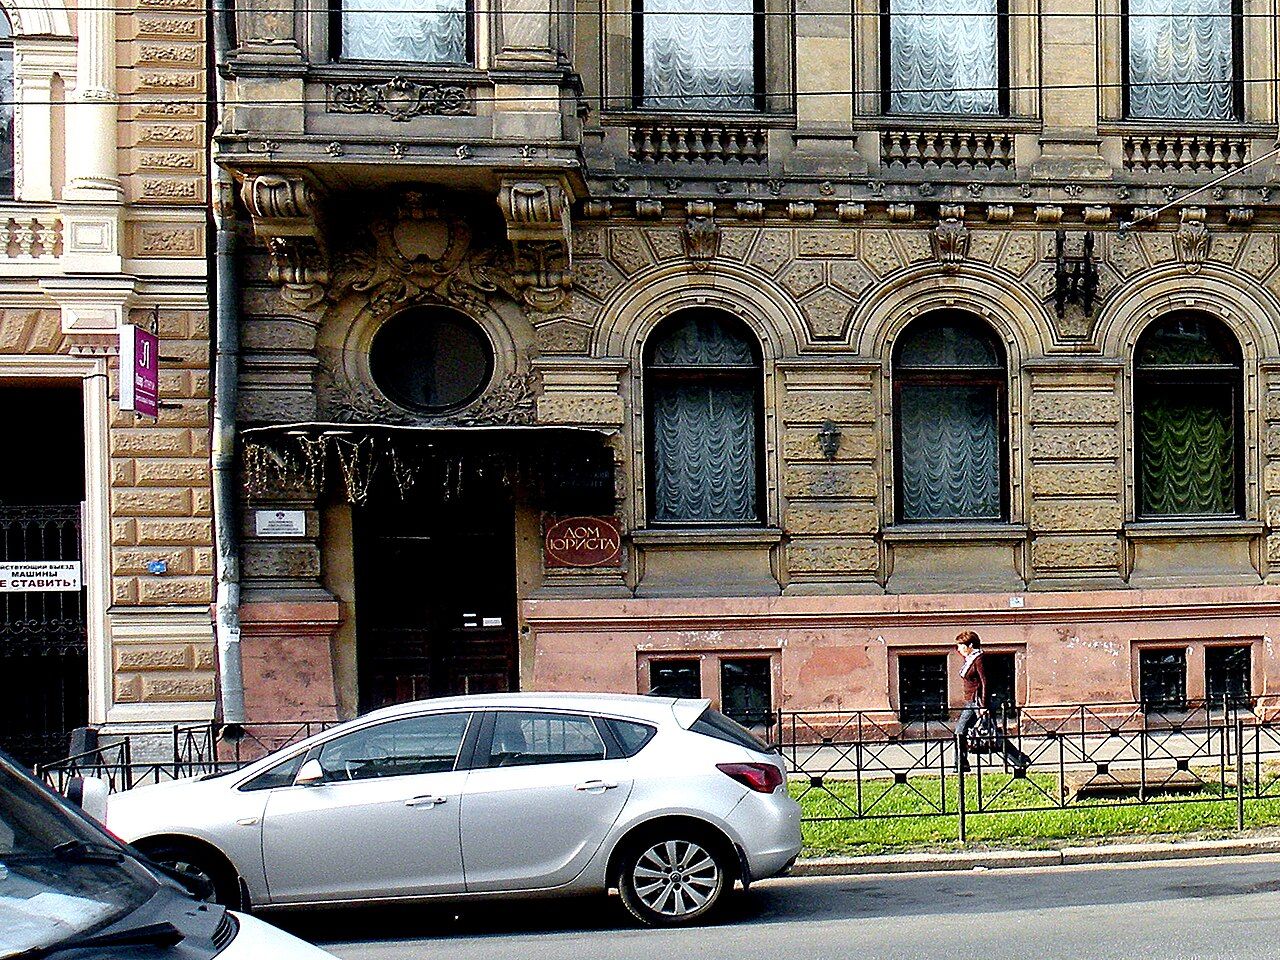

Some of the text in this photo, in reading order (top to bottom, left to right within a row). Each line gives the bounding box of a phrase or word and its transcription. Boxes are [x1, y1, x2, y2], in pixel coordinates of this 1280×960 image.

[563, 526, 600, 539] ДОМ
[550, 538, 616, 551] ЮРИСТА
[11, 578, 77, 588] СТАВИТЬ!
